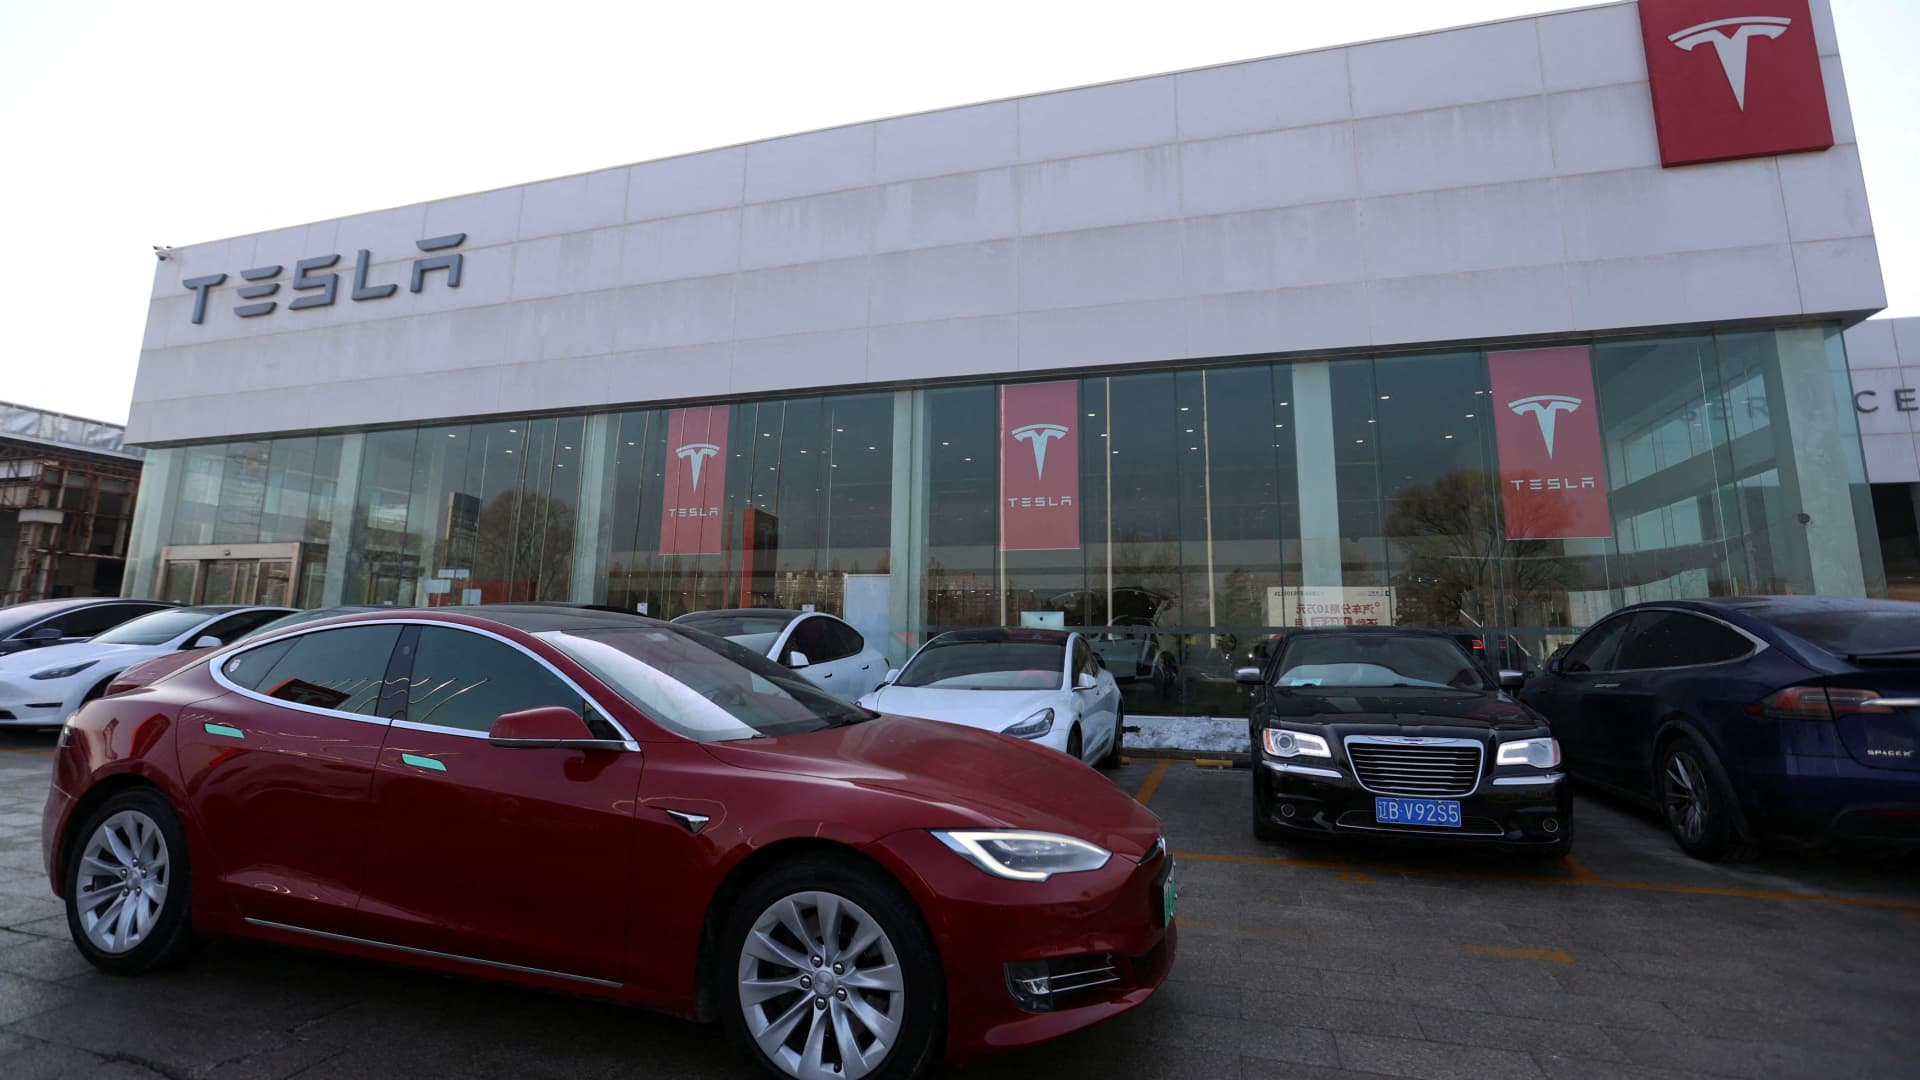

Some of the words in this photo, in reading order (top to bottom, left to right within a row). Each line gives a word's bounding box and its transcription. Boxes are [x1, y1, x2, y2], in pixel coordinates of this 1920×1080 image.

[182, 233, 467, 325] TESLA
[1509, 476, 1595, 491] TESLA
[1007, 496, 1072, 508] TESLA
[668, 507, 718, 518] TESLA
